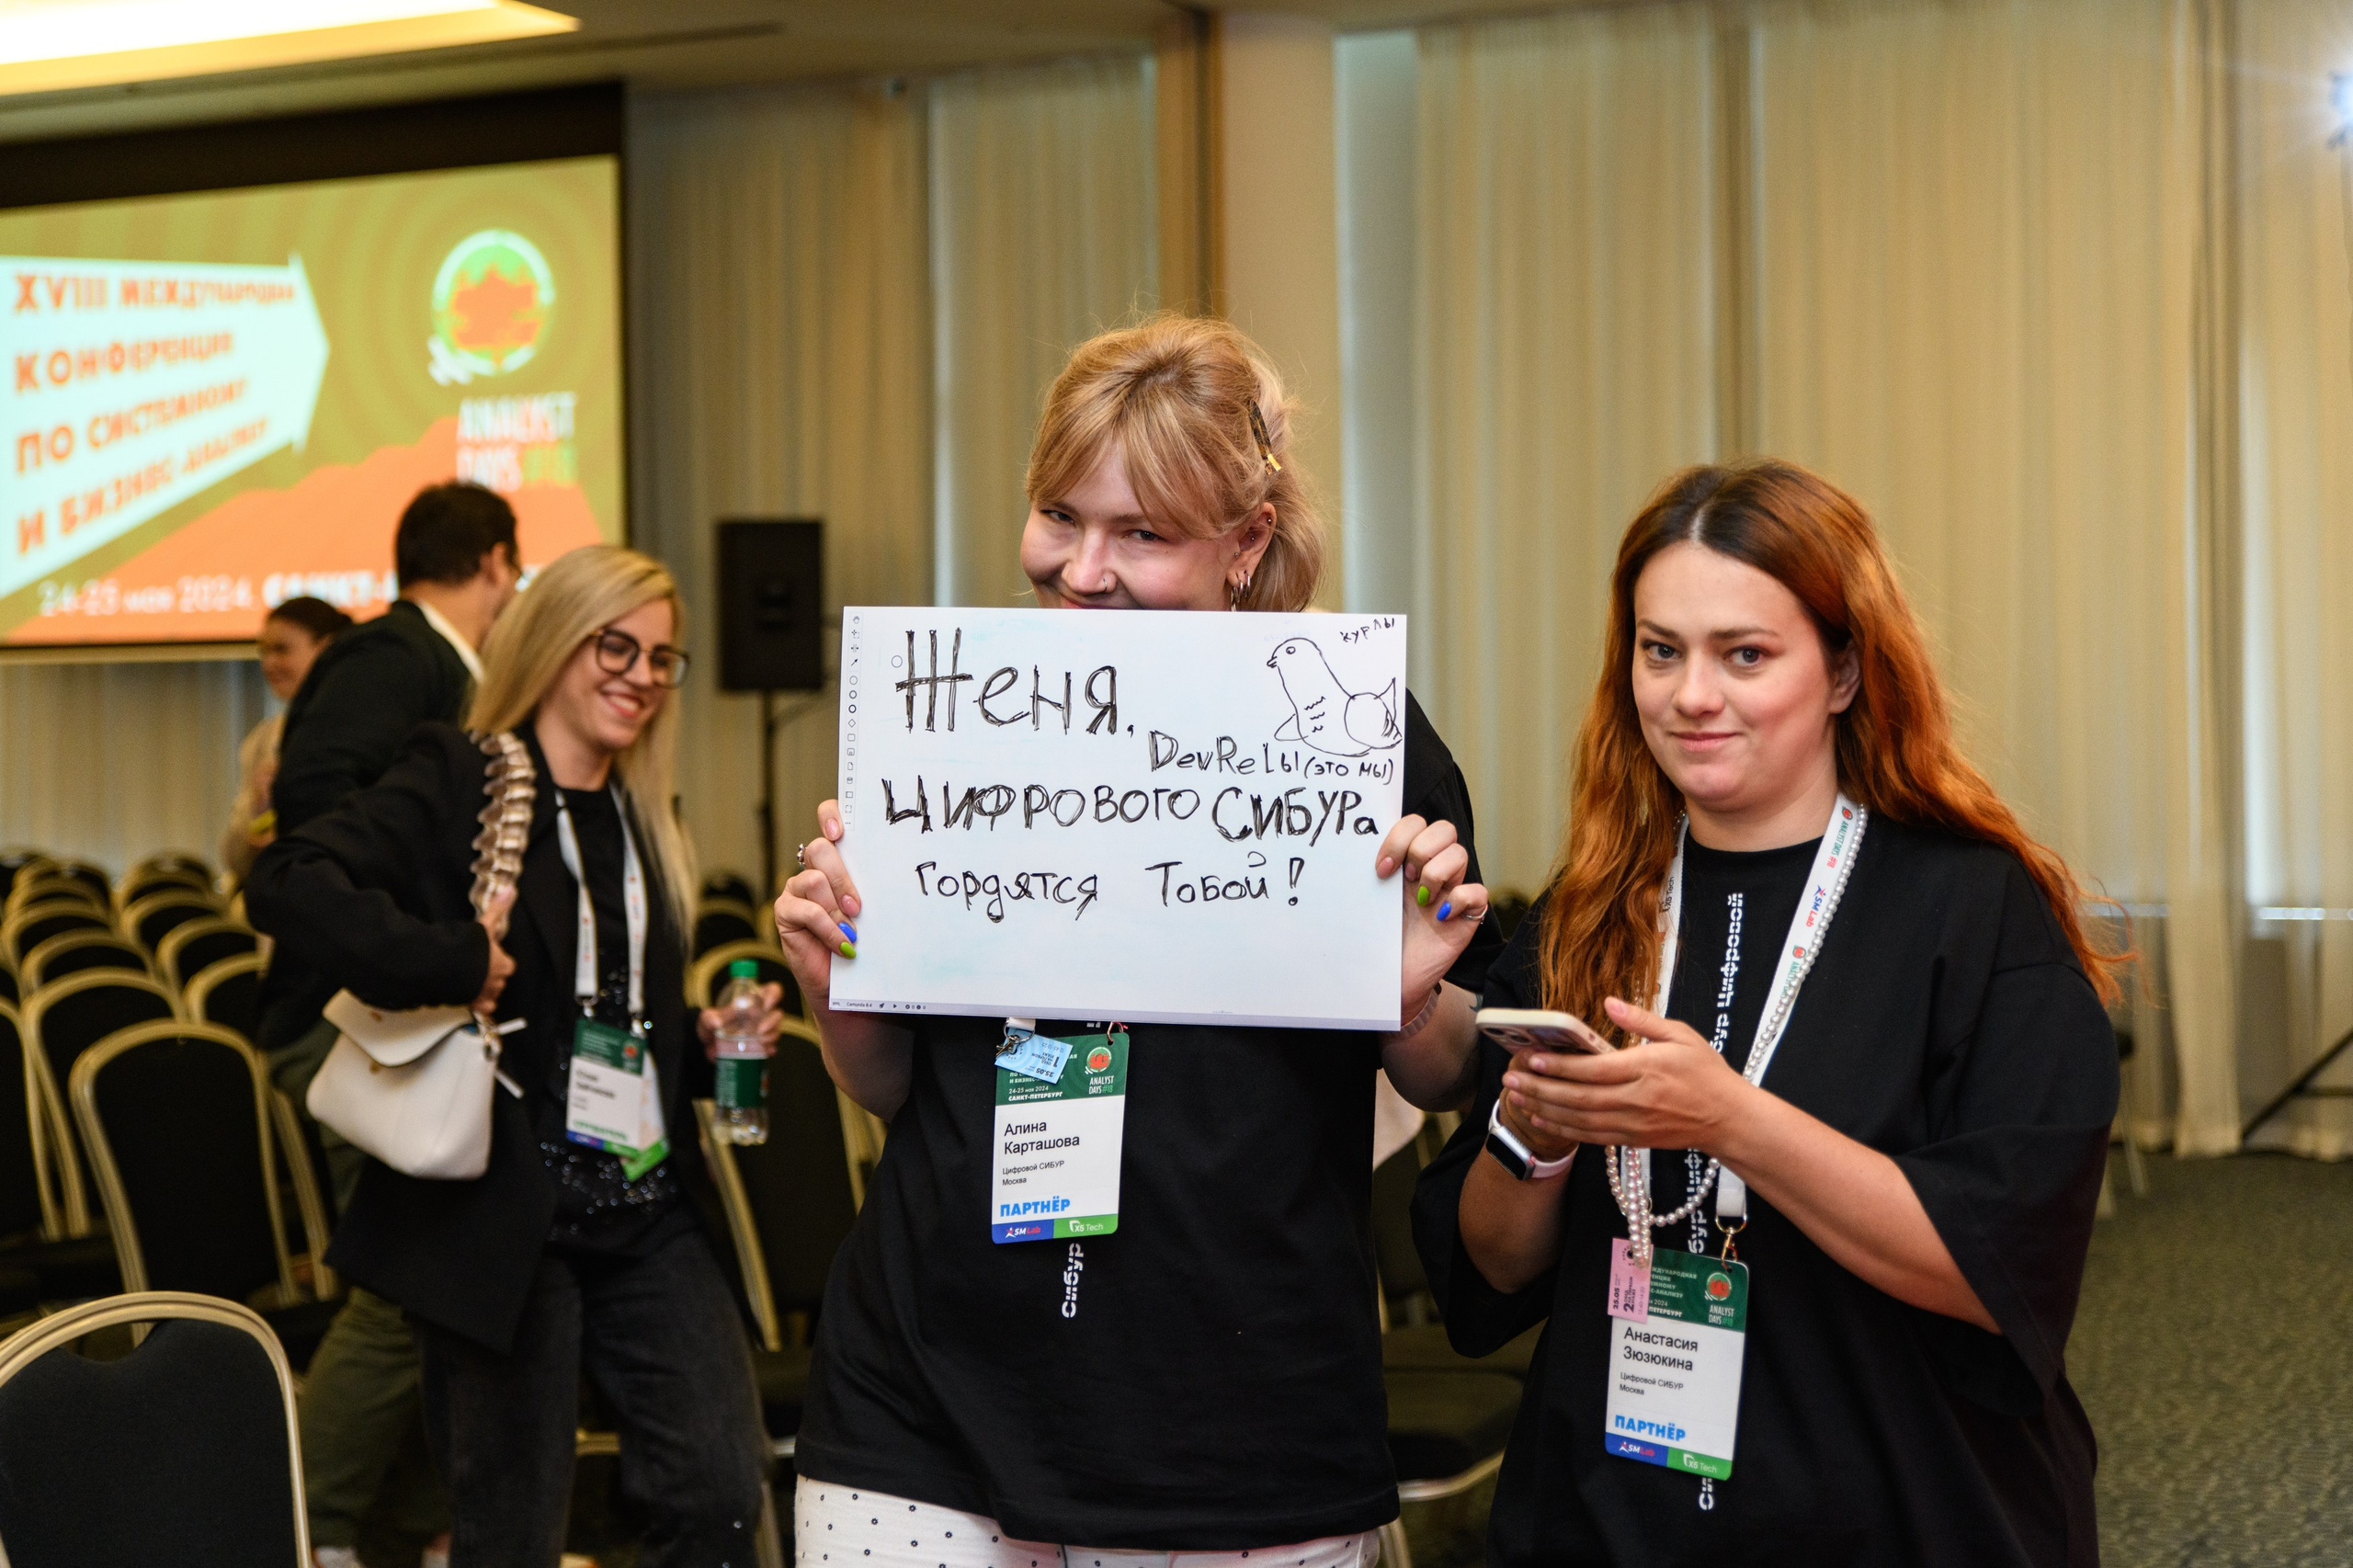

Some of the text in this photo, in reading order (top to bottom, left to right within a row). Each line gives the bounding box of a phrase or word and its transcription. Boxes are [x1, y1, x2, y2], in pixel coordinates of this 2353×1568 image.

[16, 423, 74, 474] ПО
[17, 509, 44, 555] И
[1666, 876, 1675, 893] Tech
[1717, 892, 1744, 1007] Цифровой
[1036, 1068, 1054, 1077] 25.05
[1090, 1075, 1114, 1085] ANALYST
[1008, 1092, 1063, 1101] САНКТ-ПЕТЕРБУРГ
[1089, 1085, 1113, 1095] DAYS #18
[1004, 1121, 1047, 1136] Алина
[1004, 1136, 1080, 1155] Карташова
[1002, 1160, 1064, 1176] Цифровой СИБУР
[1002, 1177, 1027, 1187] Москва
[1000, 1196, 1071, 1217] ПАРТНЁР
[1074, 1222, 1103, 1233] X5 Tech
[1062, 1243, 1084, 1318] Сибур
[1623, 1302, 1634, 1313] 2
[1710, 1305, 1733, 1317] ANALYST
[1709, 1314, 1722, 1324] DAYS
[1623, 1326, 1699, 1352] Анастасия
[1623, 1346, 1693, 1371] Зюзюкина
[1620, 1372, 1684, 1390] Цифровой СИБУР
[1620, 1383, 1644, 1395] Москва
[1615, 1415, 1686, 1442] ПАРТНЁР
[1699, 1462, 1717, 1473] Tech
